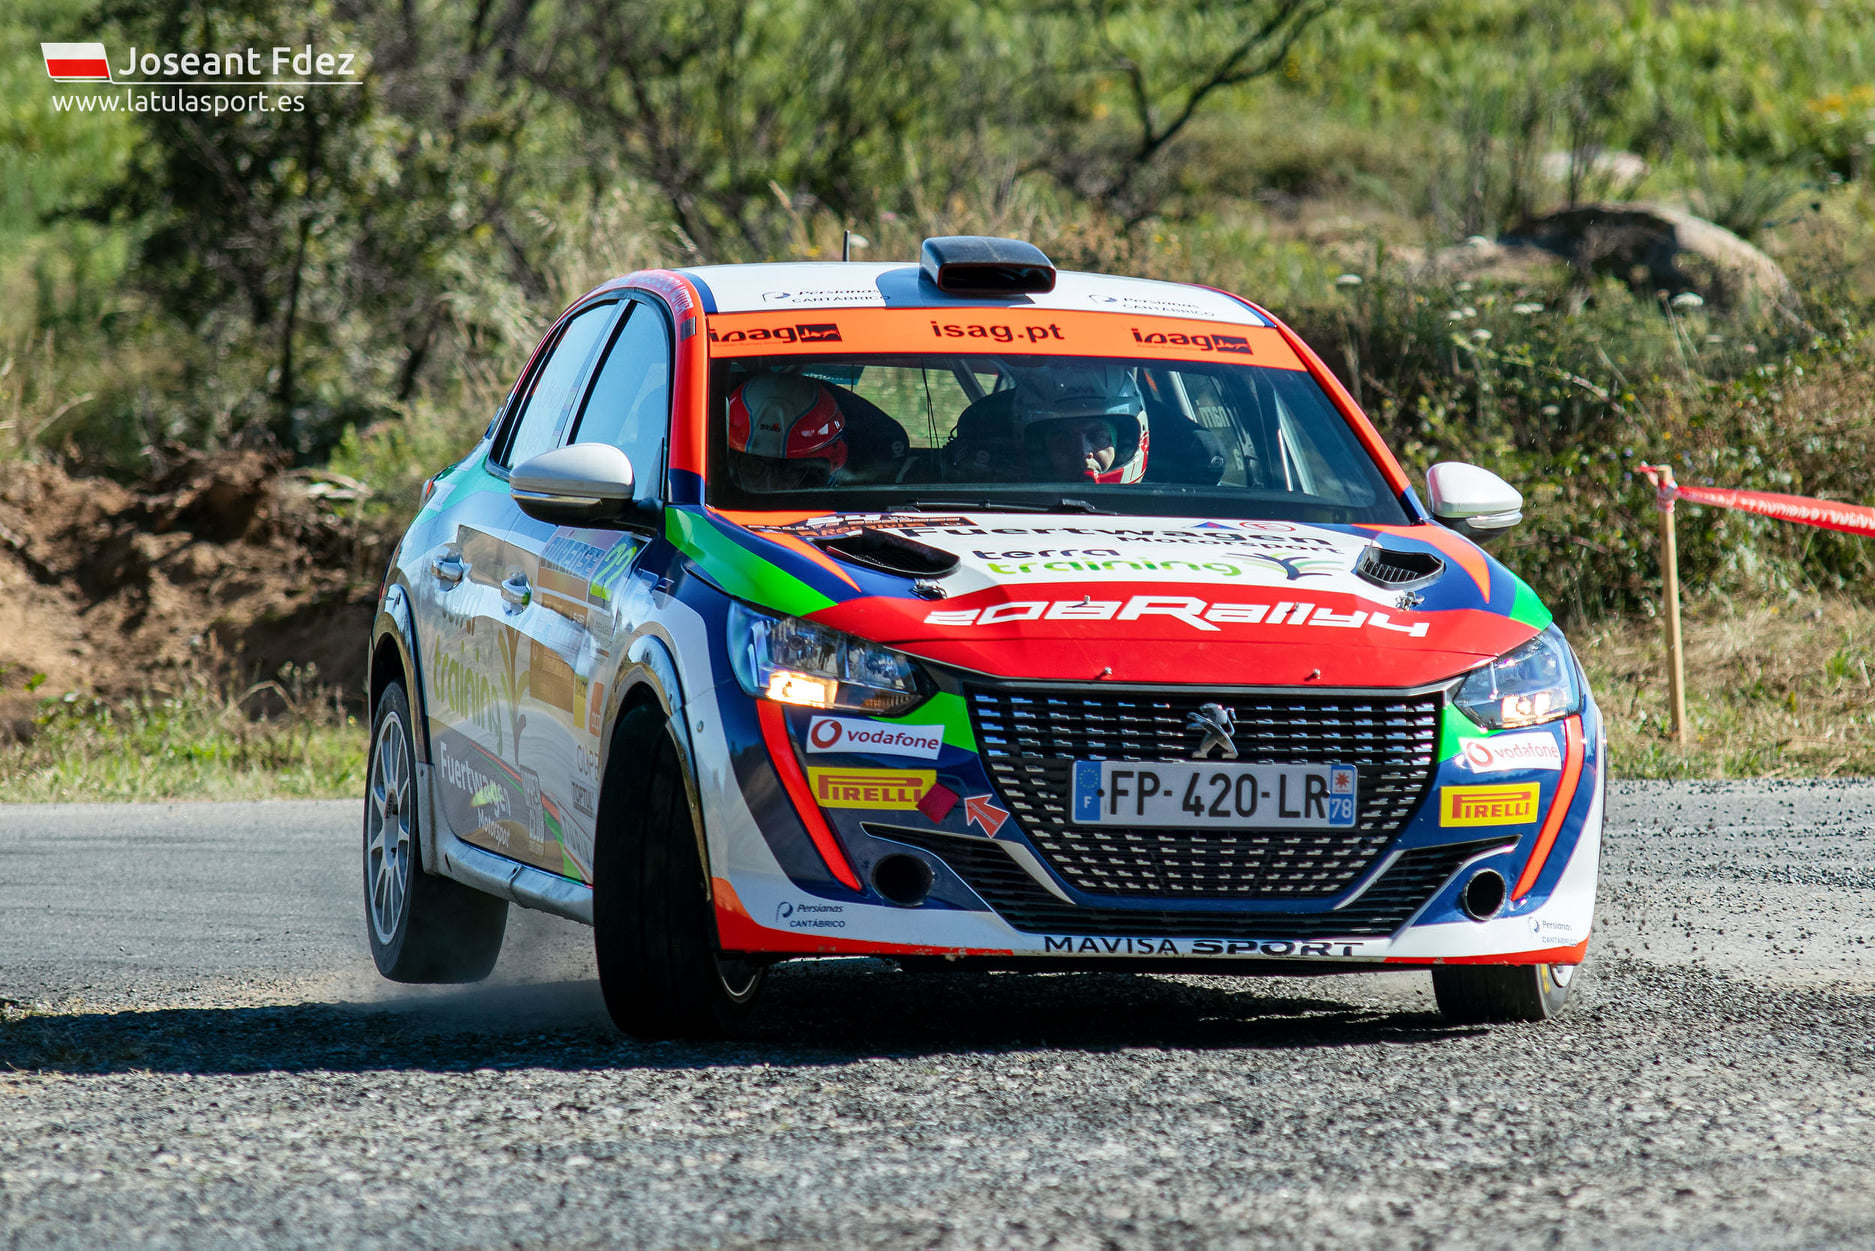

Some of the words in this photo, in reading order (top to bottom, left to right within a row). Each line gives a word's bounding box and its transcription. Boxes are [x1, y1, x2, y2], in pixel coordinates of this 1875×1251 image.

[930, 320, 1065, 343] isag.pt
[899, 526, 1333, 547] Fuertwagen
[1117, 536, 1344, 555] Motorsport
[972, 548, 1121, 560] terra
[987, 557, 1243, 577] training
[924, 595, 1430, 637] 208Rally4
[433, 633, 504, 757] training
[847, 730, 940, 750] vodafone
[1494, 743, 1560, 759] vodafone
[440, 741, 512, 817] Fuertwagen
[818, 774, 924, 803] PIRELLI
[1084, 796, 1092, 809] F
[1110, 770, 1327, 819] FP-420-LR
[1452, 791, 1532, 819] PIRELLI
[1331, 798, 1352, 819] 78
[797, 903, 843, 913] Persianas
[790, 919, 845, 928] CANTÁBRICO
[1044, 936, 1178, 955] MAVISA
[1191, 940, 1365, 957] SPORT
